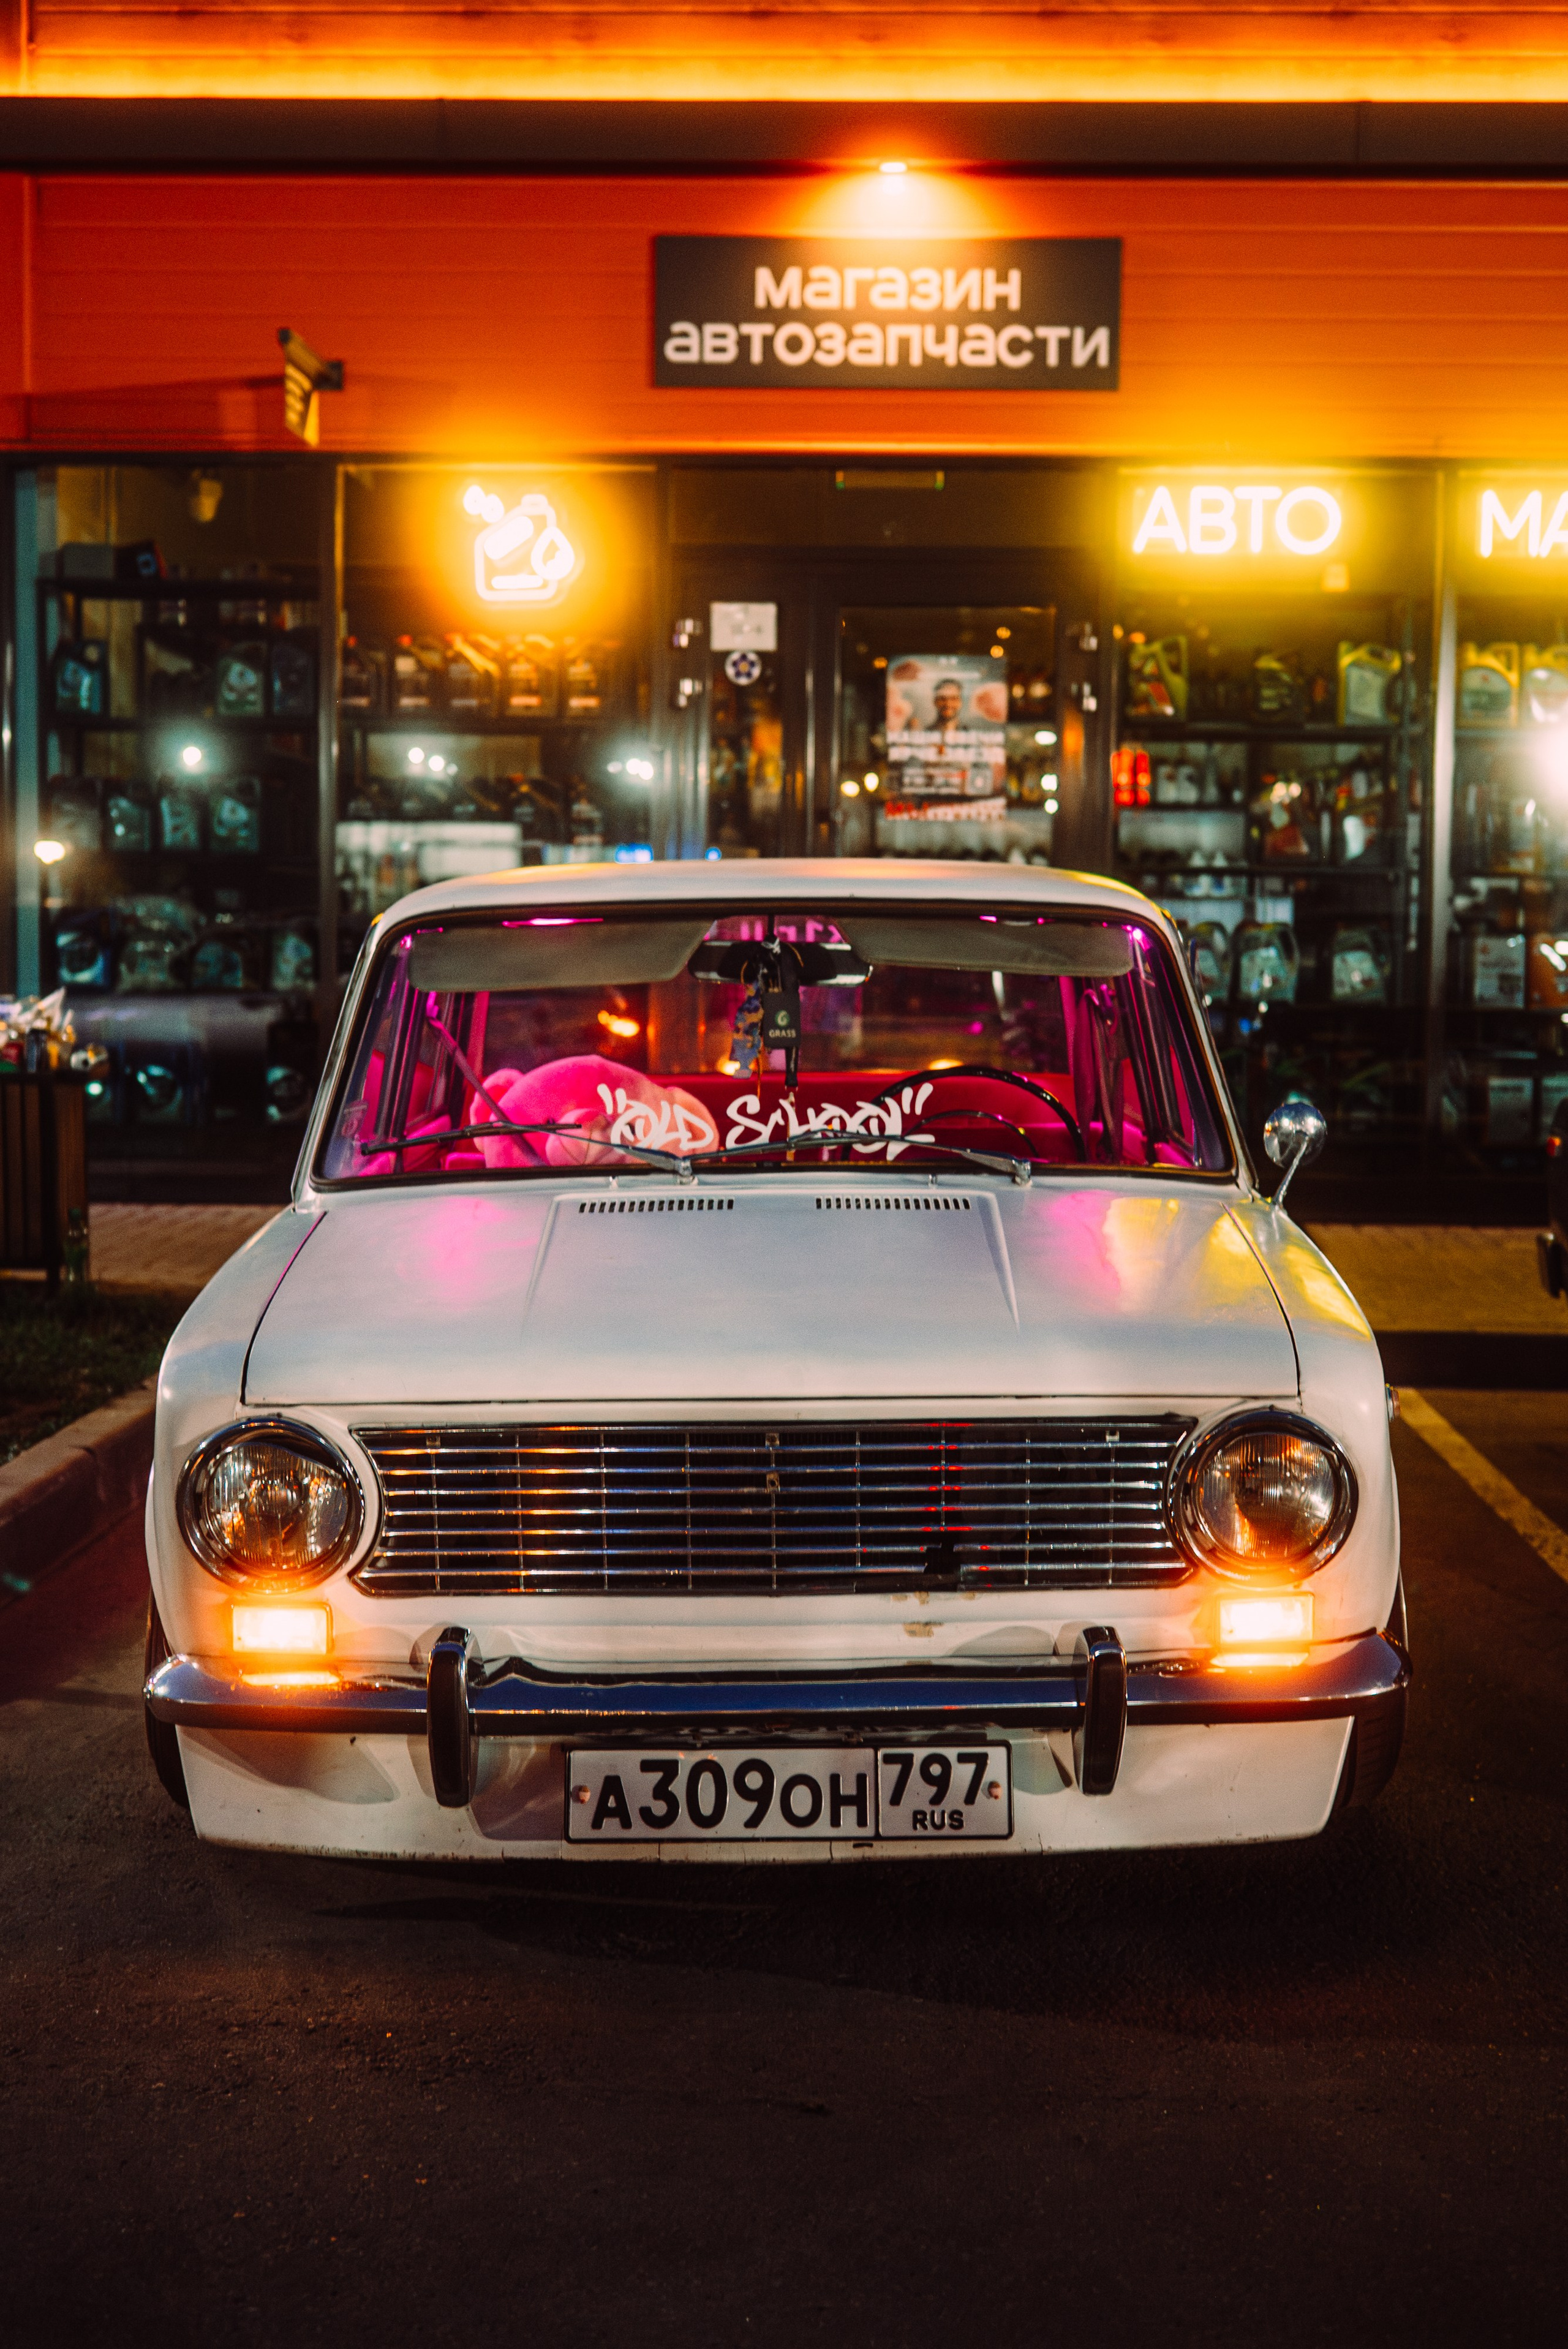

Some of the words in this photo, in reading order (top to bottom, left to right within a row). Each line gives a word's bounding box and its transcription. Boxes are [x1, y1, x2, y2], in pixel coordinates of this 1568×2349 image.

[754, 266, 1022, 311] магазин
[663, 322, 1110, 368] автозапчасти
[1133, 485, 1342, 554] АВТО
[768, 1028, 796, 1038] GRASS
[882, 1752, 990, 1806] 797
[911, 1809, 965, 1831] RUS
